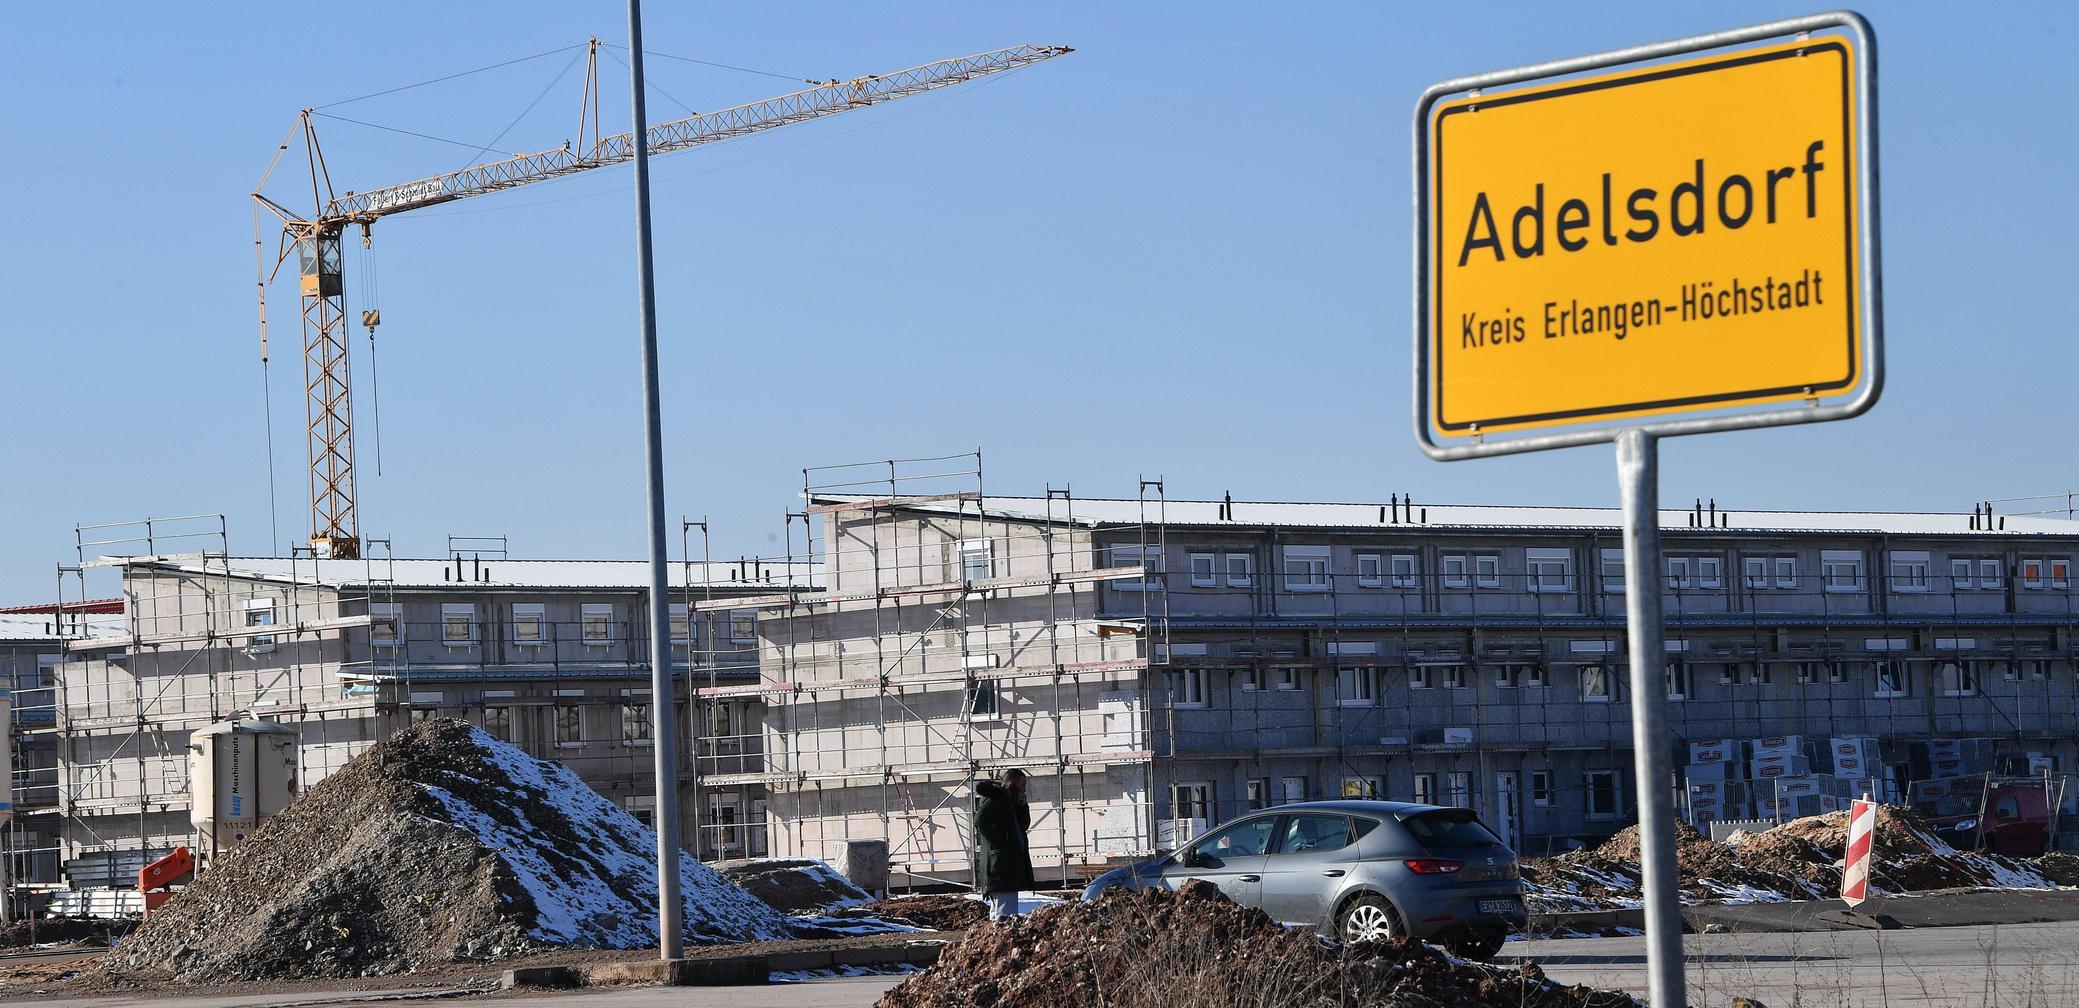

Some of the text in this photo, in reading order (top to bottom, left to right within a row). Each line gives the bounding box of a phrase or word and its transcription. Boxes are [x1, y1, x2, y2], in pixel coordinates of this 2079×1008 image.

[1458, 140, 1824, 267] Adelsdorf
[1462, 269, 1823, 349] Kreis Erlangen-Höchstadt
[232, 737, 240, 794] Maschinenputz
[224, 821, 252, 830] 11121
